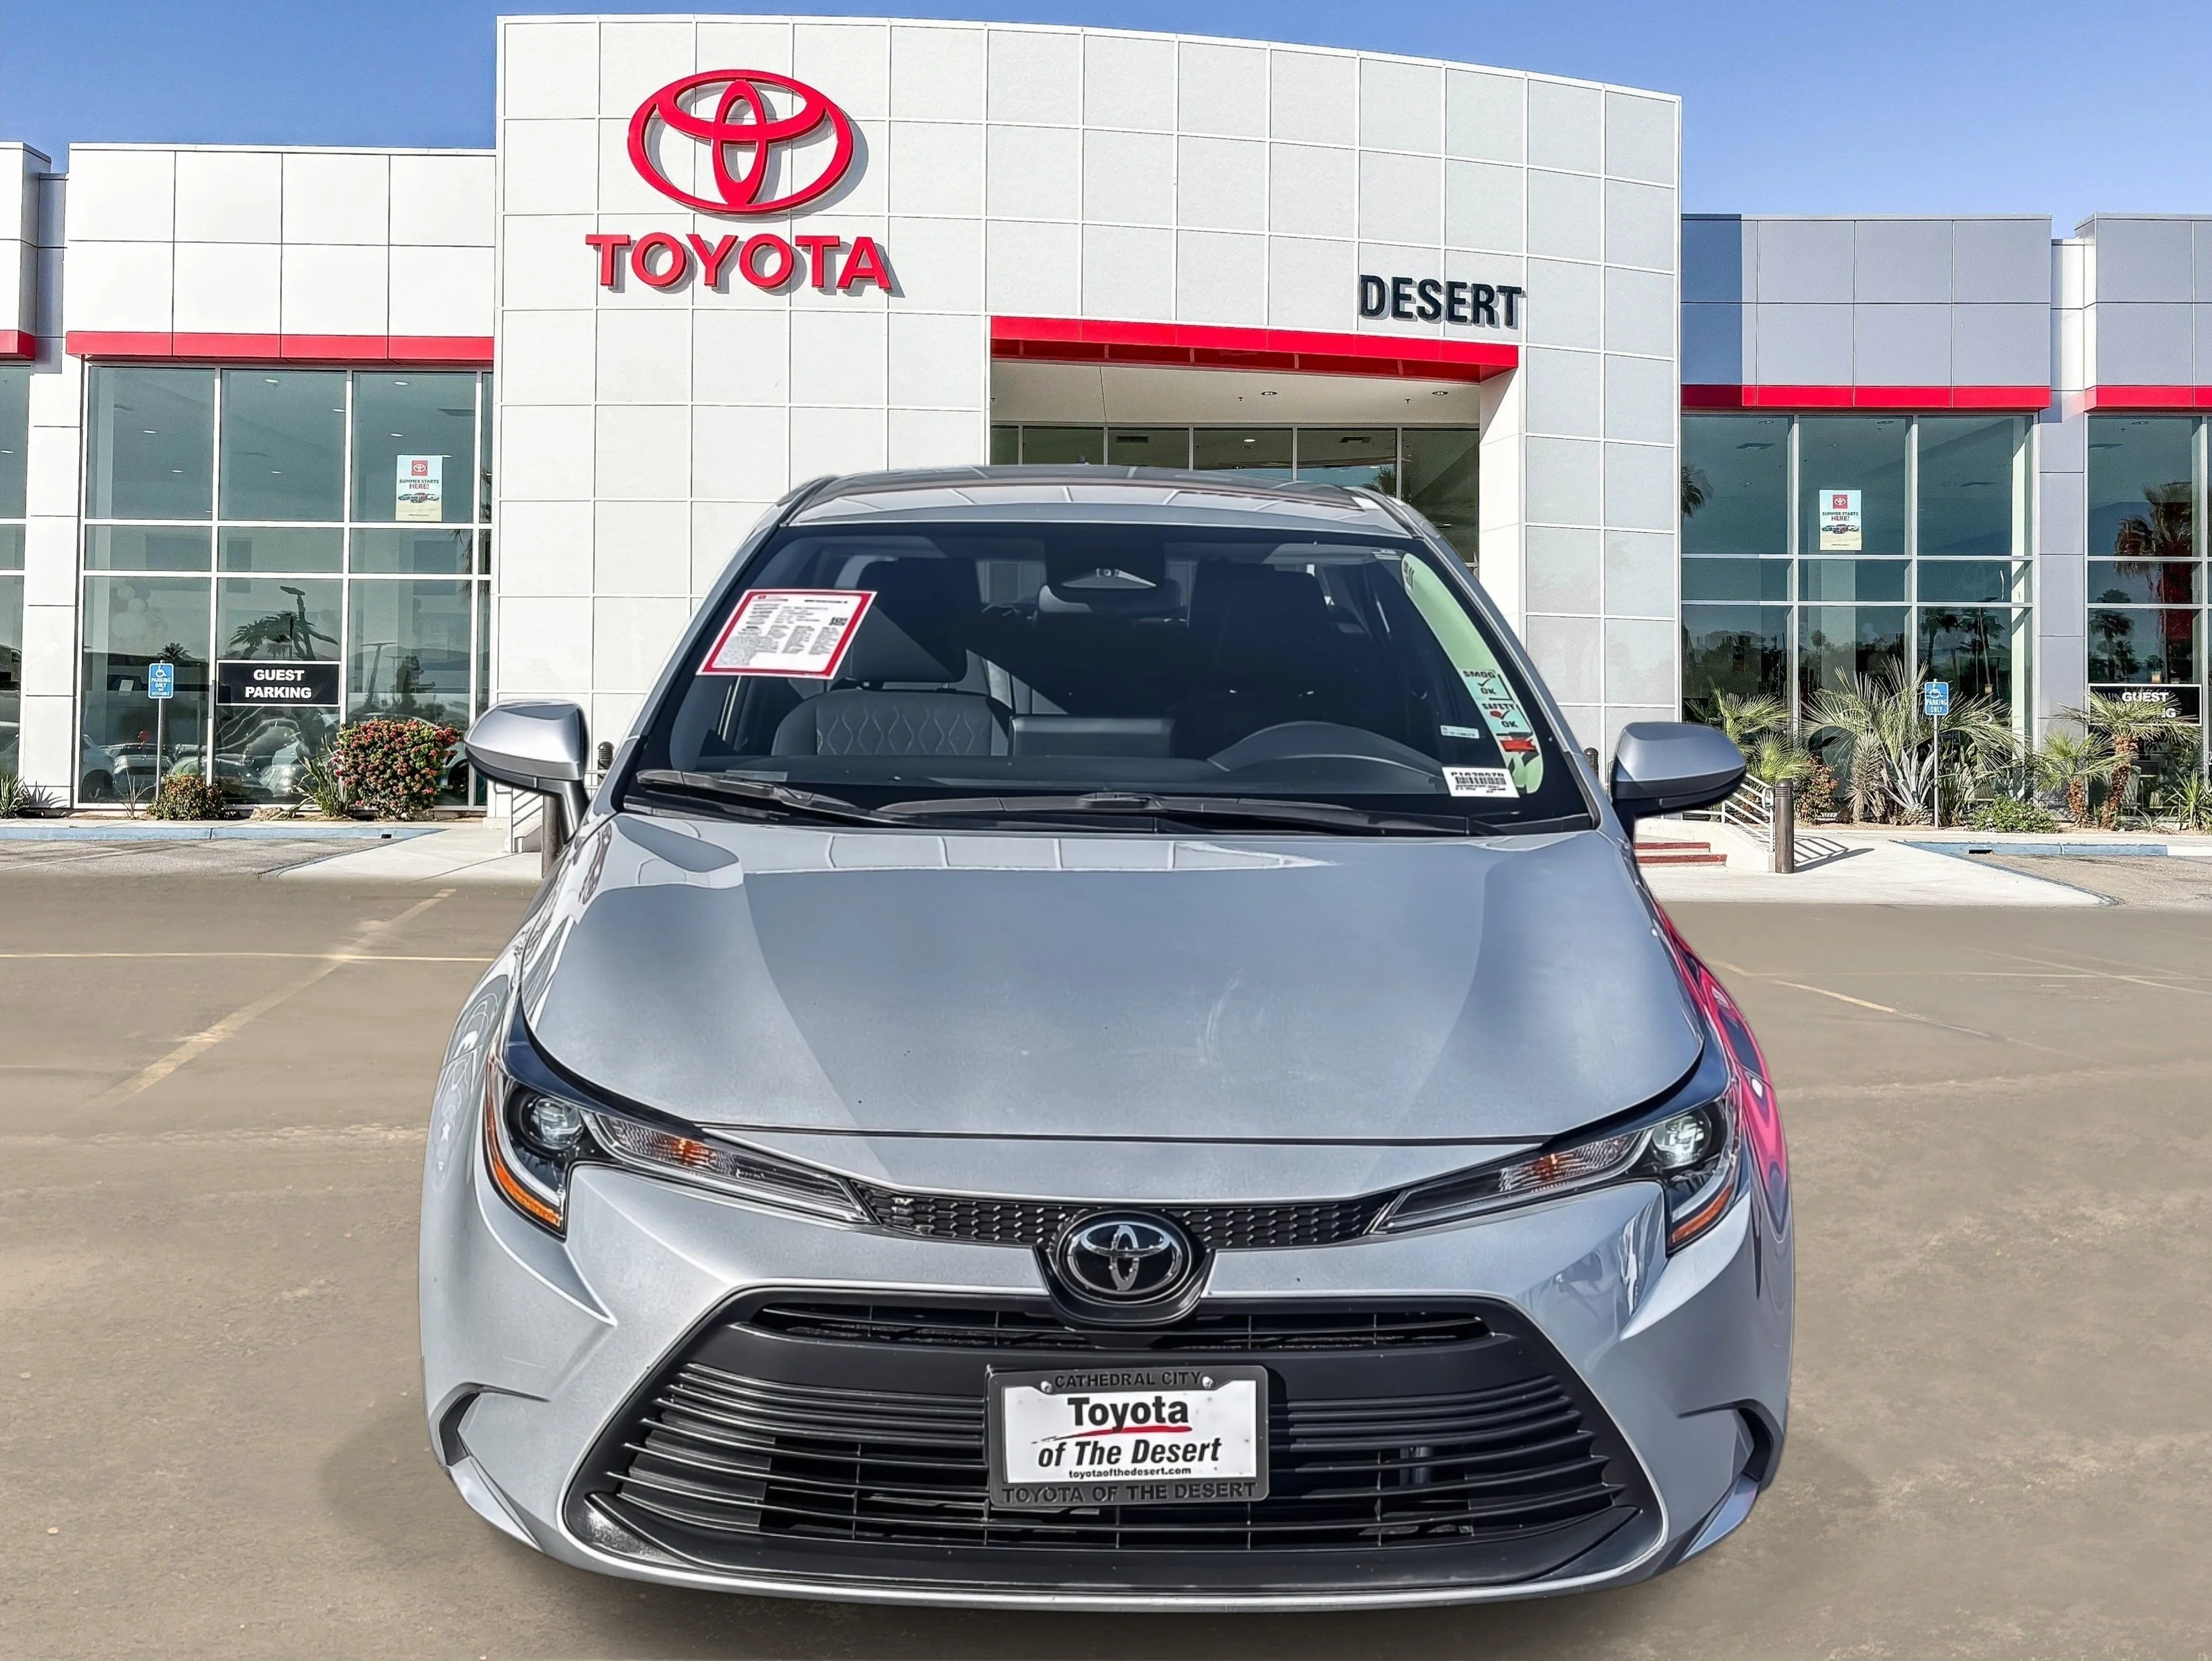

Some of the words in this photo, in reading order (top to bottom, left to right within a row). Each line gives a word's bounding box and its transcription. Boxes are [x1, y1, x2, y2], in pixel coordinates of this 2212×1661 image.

[585, 232, 893, 293] TOYOTA
[1359, 274, 1522, 327] DESERT
[253, 669, 305, 681] GUEST
[1462, 670, 1496, 678] SMOG
[245, 686, 312, 699] PARKING
[1480, 687, 1496, 695] OK
[2121, 691, 2169, 703] GUEST
[1481, 703, 1515, 711] SAFETY
[1501, 720, 1519, 728] OK
[1054, 1372, 1156, 1389] CATHEDRAL
[1162, 1370, 1202, 1385] CITY
[1067, 1396, 1189, 1433] Toyota
[1038, 1442, 1067, 1468] of
[1075, 1441, 1121, 1466] The
[1131, 1438, 1221, 1464] Desert
[1068, 1466, 1192, 1479] toyotaofthedesert.com
[1002, 1487, 1084, 1503] TOYOTA
[1092, 1487, 1119, 1501] OF
[1127, 1484, 1167, 1501] THE
[1174, 1482, 1257, 1499] DESERT
